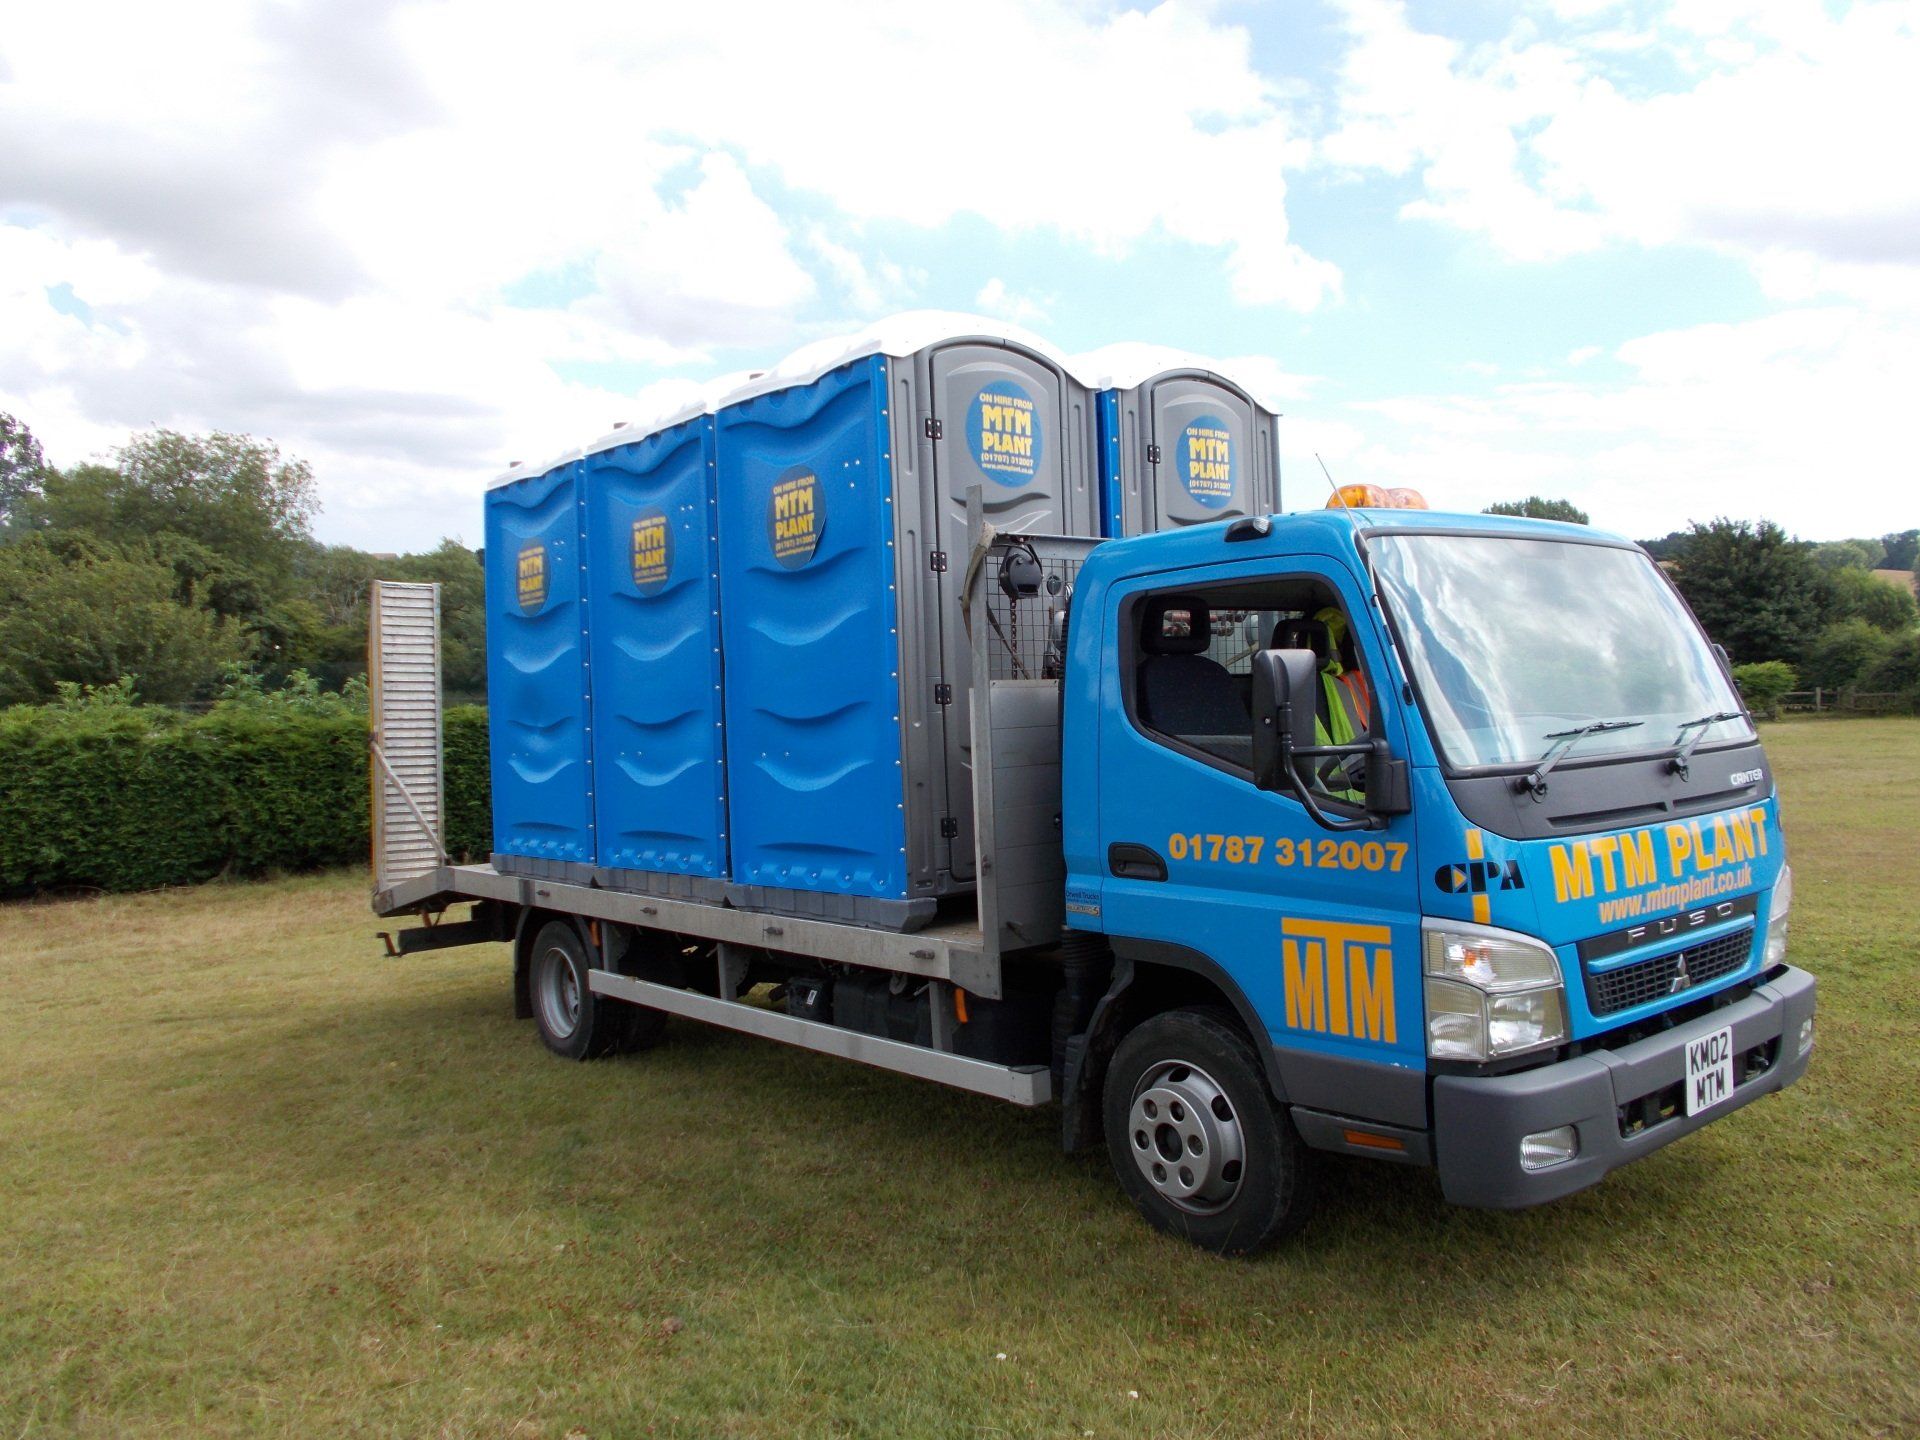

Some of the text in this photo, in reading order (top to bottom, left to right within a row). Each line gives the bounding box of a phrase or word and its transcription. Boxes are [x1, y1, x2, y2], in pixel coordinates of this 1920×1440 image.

[979, 392, 1033, 410] ON HIRE FROM
[982, 404, 1031, 436] MTM
[982, 431, 1032, 456] PLANT
[1187, 427, 1197, 436] ON
[1215, 430, 1229, 440] FROM
[1189, 437, 1229, 463] MTM
[1189, 461, 1230, 480] PLANT
[773, 486, 782, 495] ON
[797, 474, 815, 488] FROM
[775, 487, 813, 520] MTM
[634, 525, 665, 551] MTM
[775, 512, 814, 540] PLANT
[519, 555, 543, 577] MTM
[635, 547, 666, 569] PLANT
[519, 574, 544, 593] PLANT
[1730, 768, 1763, 786] CANTER
[1168, 833, 1409, 872] 01787 312007
[1548, 806, 1768, 903] MTM PLANT
[1599, 862, 1752, 924] www.mtmplant.co.uk
[1627, 902, 1734, 944] FUSO
[1281, 917, 1397, 1044] MTM
[1690, 1031, 1728, 1075] KM02
[1696, 1067, 1725, 1108] MTM
